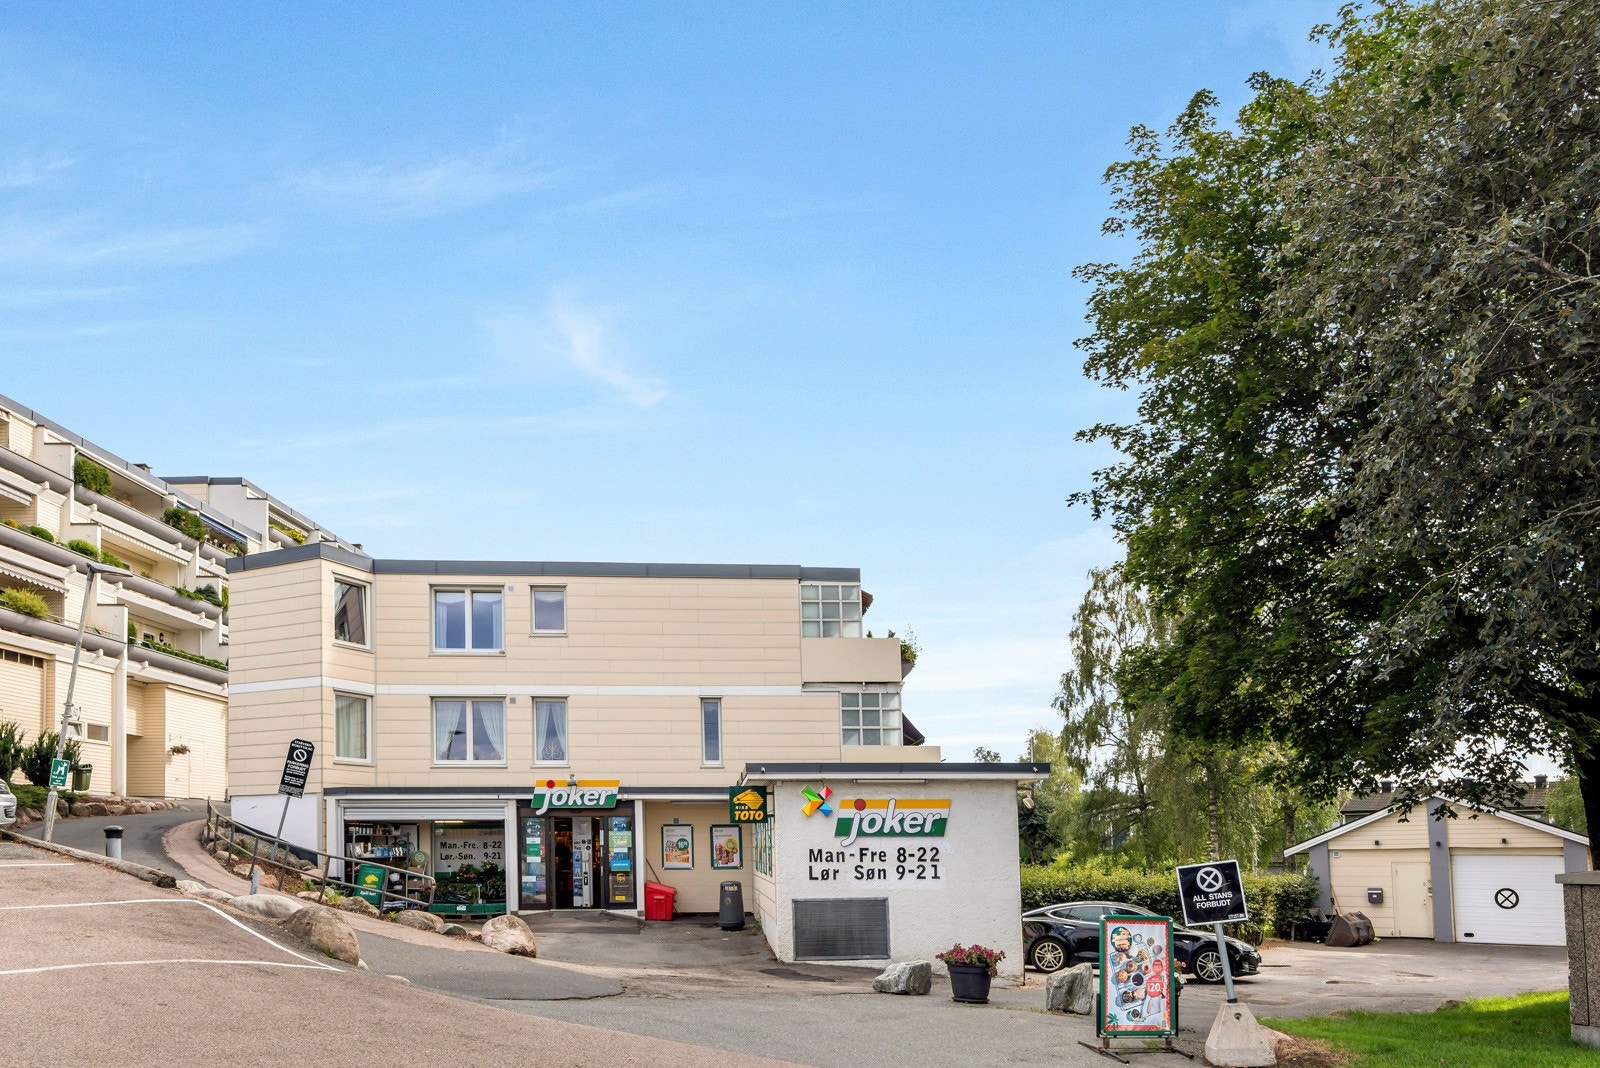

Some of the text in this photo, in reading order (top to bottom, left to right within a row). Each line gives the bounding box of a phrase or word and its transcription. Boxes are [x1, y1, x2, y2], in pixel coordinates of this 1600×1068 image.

[535, 780, 614, 815] joker
[734, 810, 764, 820] TOTO
[840, 798, 941, 847] joker
[483, 841, 502, 849] 8-22
[896, 846, 940, 864] 8-22
[808, 864, 940, 880] Lør Søn 9-21
[1192, 892, 1233, 902] ALL STANS
[1196, 899, 1231, 909] FORBUDT
